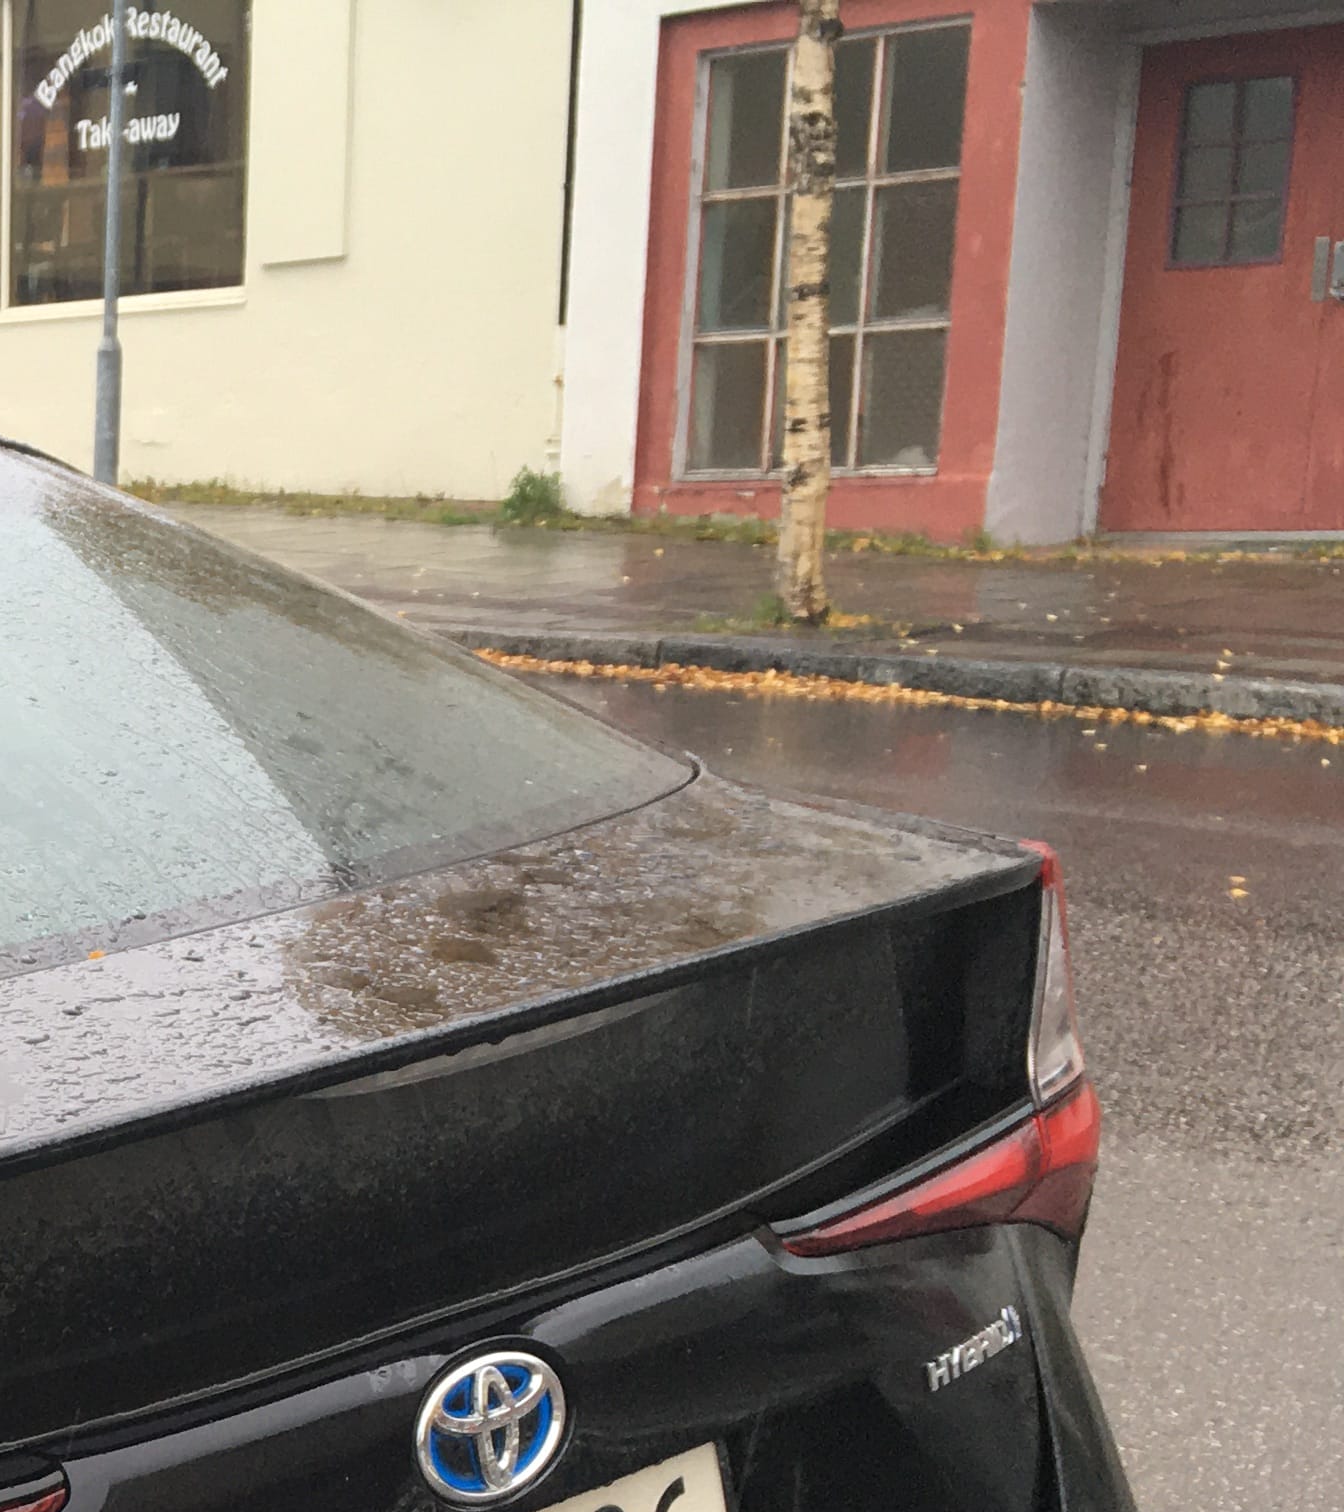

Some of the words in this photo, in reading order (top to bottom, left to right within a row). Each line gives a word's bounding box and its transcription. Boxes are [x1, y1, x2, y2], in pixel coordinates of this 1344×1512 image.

[34, 13, 116, 109] Bangkok
[126, 6, 229, 89] Restaurant
[75, 112, 180, 151] Tak-away
